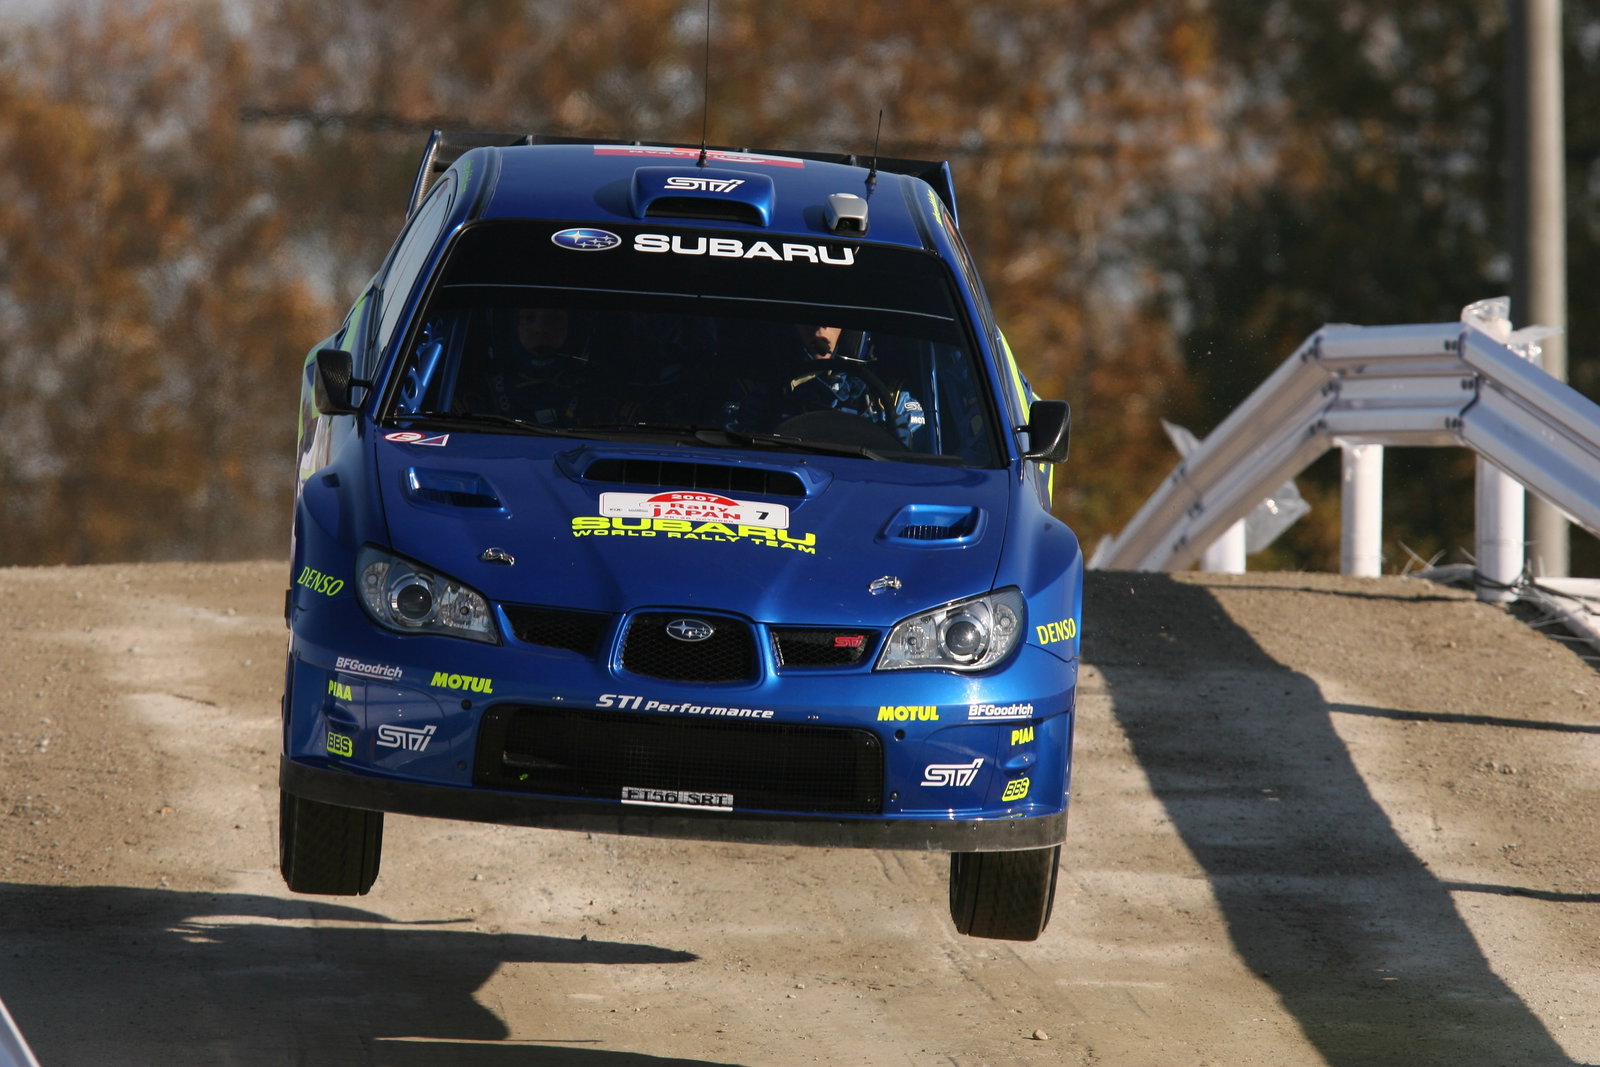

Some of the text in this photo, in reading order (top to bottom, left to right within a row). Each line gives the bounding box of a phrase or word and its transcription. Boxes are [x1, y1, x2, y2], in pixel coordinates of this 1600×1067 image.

[633, 233, 855, 266] SUBARU
[670, 503, 728, 512] Rally
[671, 494, 719, 502] 2007
[755, 510, 770, 521] 7
[571, 516, 817, 547] SUBARU
[572, 530, 816, 555] WORLD RALLY TEAM
[297, 566, 345, 597] DENSO
[1036, 617, 1076, 645] DENSO
[336, 656, 403, 679] BFGoodrich
[328, 680, 353, 701] PIAA
[431, 671, 493, 694] MOTUL
[595, 694, 775, 719] STI Performance
[877, 705, 940, 722] MOTUL
[968, 703, 1034, 717] BFGoodrich
[328, 732, 351, 755] BBS
[1010, 726, 1035, 746] PIAA
[1003, 778, 1029, 799] BBS
[687, 793, 728, 807] SRT
